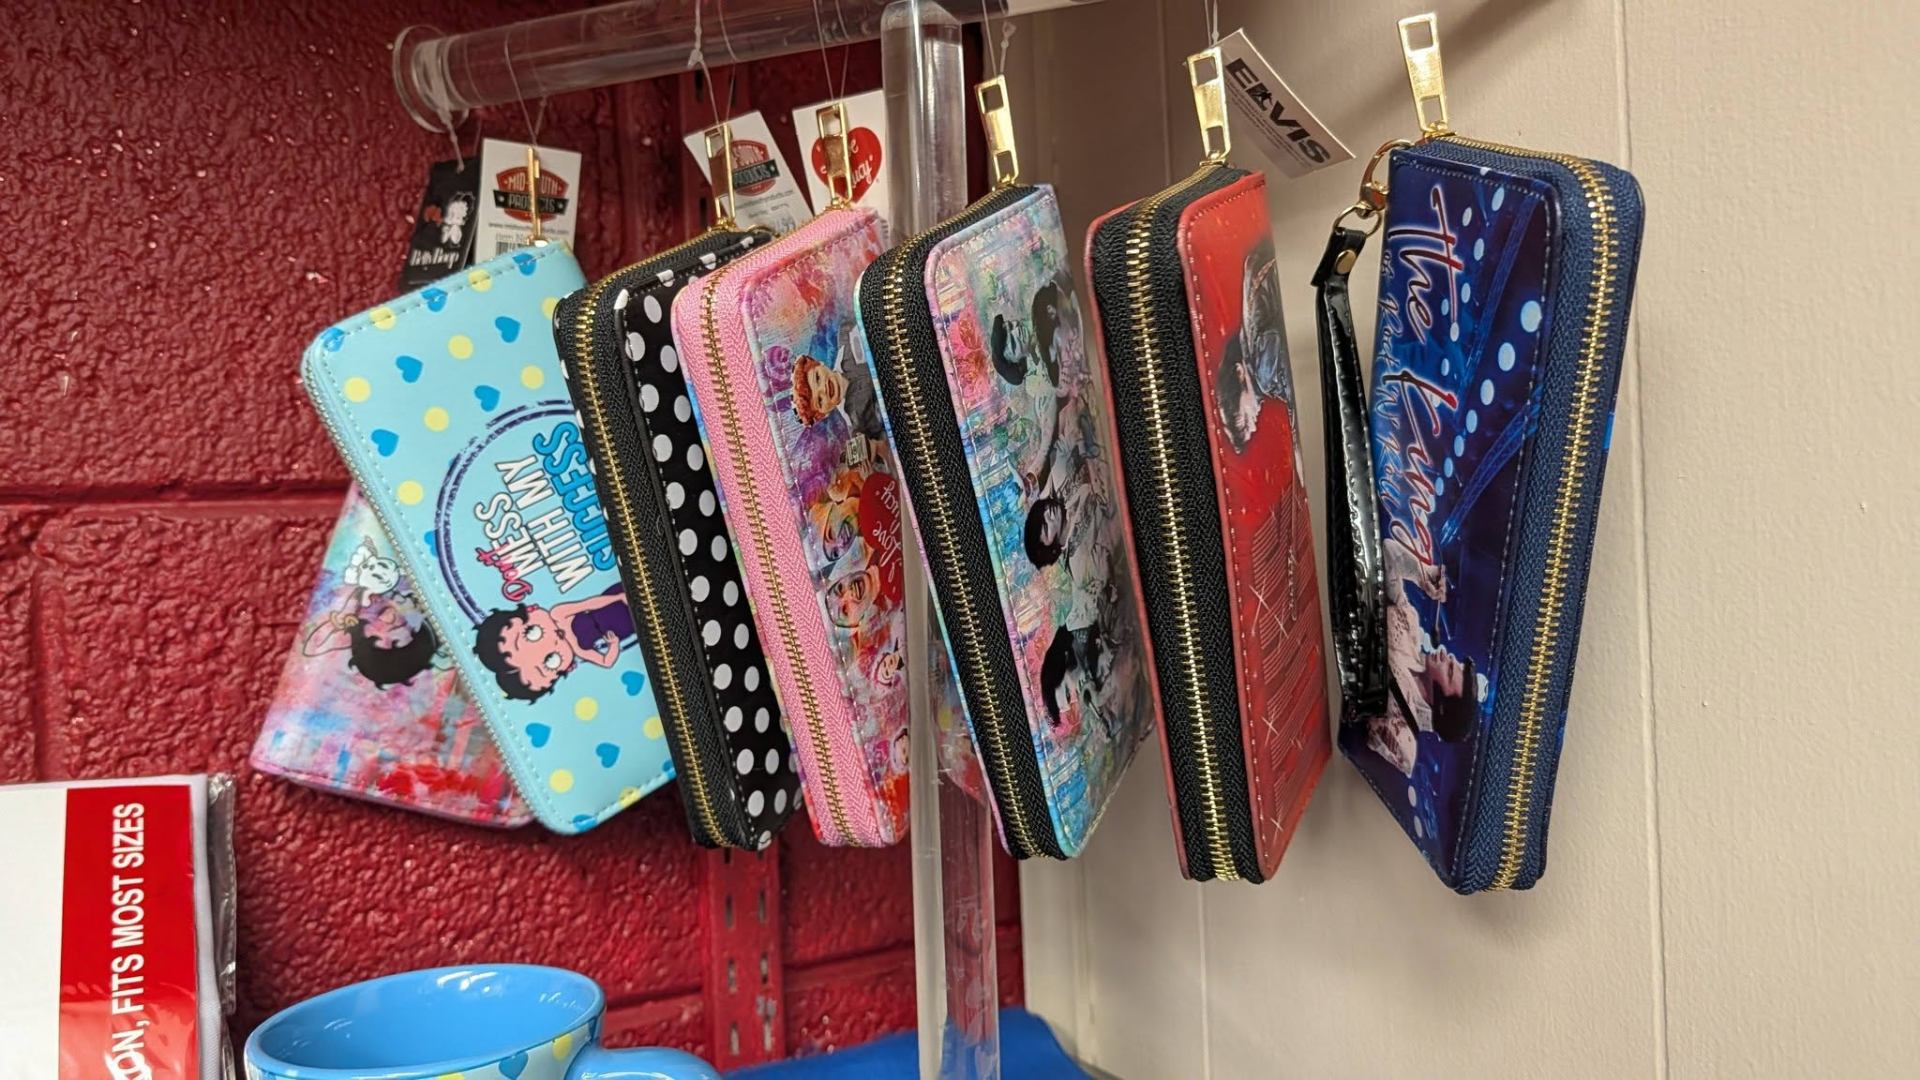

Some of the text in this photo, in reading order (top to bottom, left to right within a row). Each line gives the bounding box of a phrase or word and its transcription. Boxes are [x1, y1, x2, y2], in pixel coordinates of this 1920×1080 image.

[1225, 57, 1331, 164] ELVIS
[1382, 184, 1464, 568] The King
[473, 492, 545, 580] MESS
[495, 454, 595, 595] WITH MY
[108, 802, 151, 1080] ON, FITS MOST SIZES
